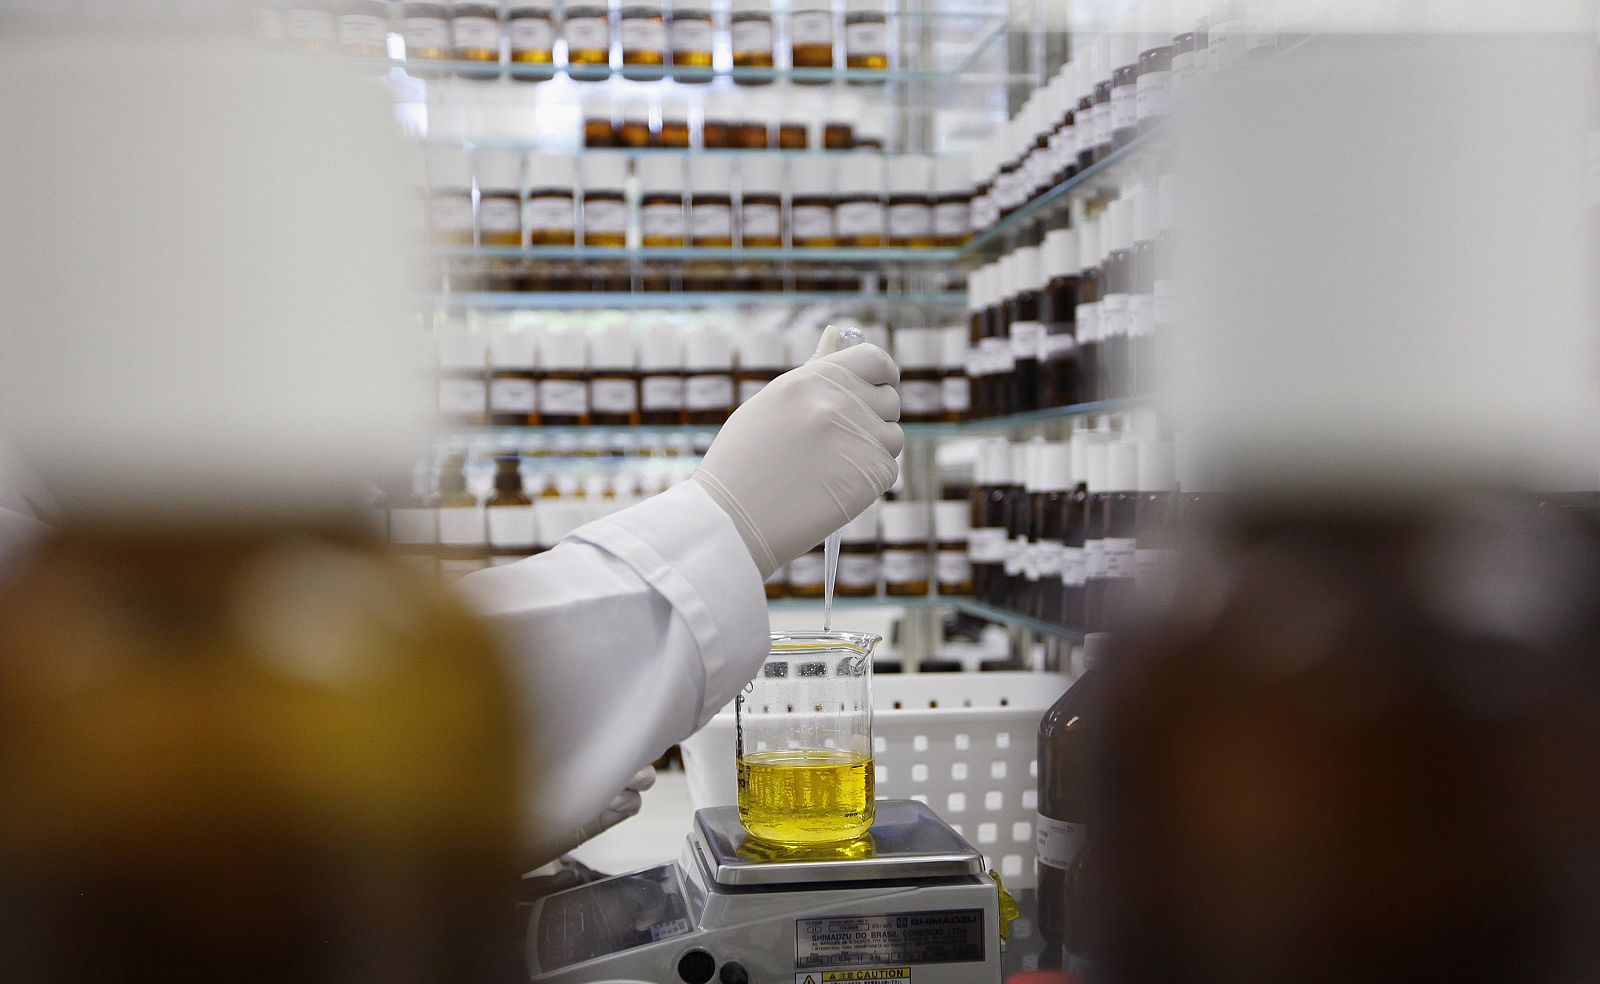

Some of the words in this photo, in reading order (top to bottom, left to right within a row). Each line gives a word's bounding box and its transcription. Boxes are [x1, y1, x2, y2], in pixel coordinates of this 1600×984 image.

[910, 915, 976, 926] SHIMADZU
[811, 933, 852, 942] SHIMADZU
[856, 932, 867, 940] DO
[870, 930, 898, 939] BRASIL
[856, 969, 904, 980] CAUTION
